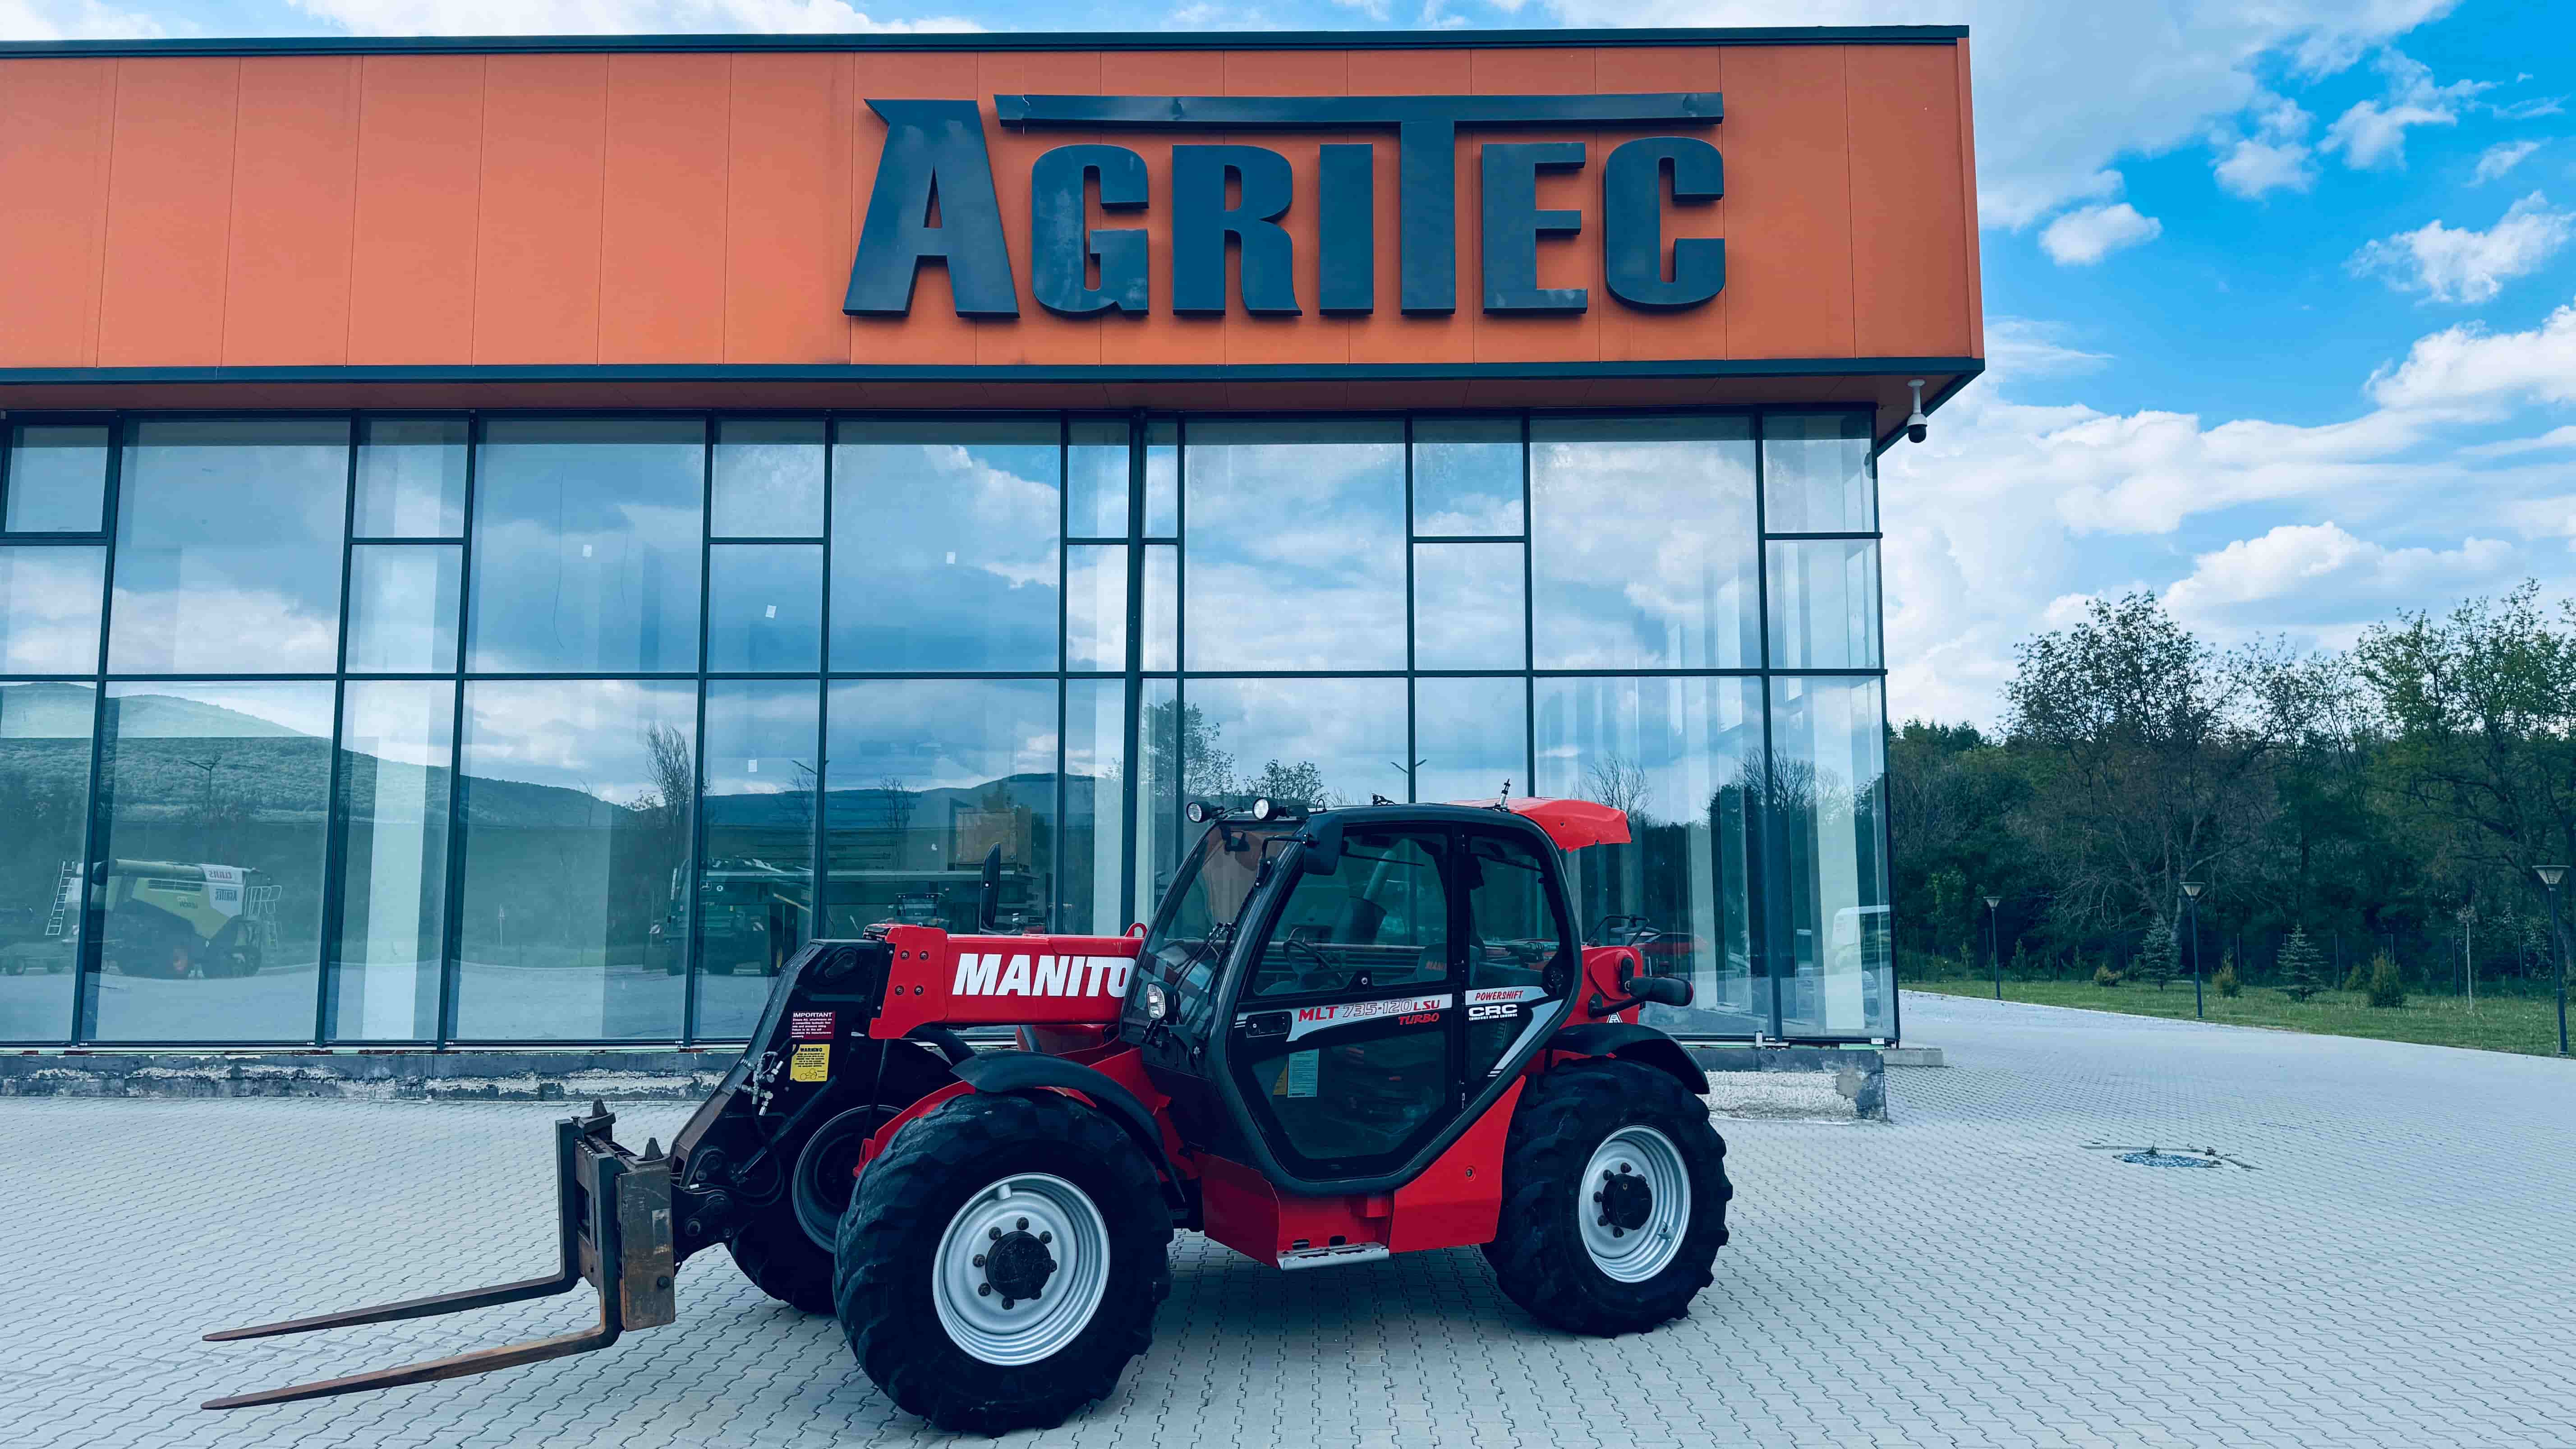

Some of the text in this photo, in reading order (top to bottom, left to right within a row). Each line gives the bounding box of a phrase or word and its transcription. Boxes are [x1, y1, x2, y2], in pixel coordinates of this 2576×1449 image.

[842, 92, 1725, 318] AGRITEC
[1475, 990, 1523, 1001] POWERSHIFT
[1298, 1006, 1339, 1022] MLT
[1469, 1004, 1518, 1017] CRC
[1398, 1012, 1440, 1025] TURBO
